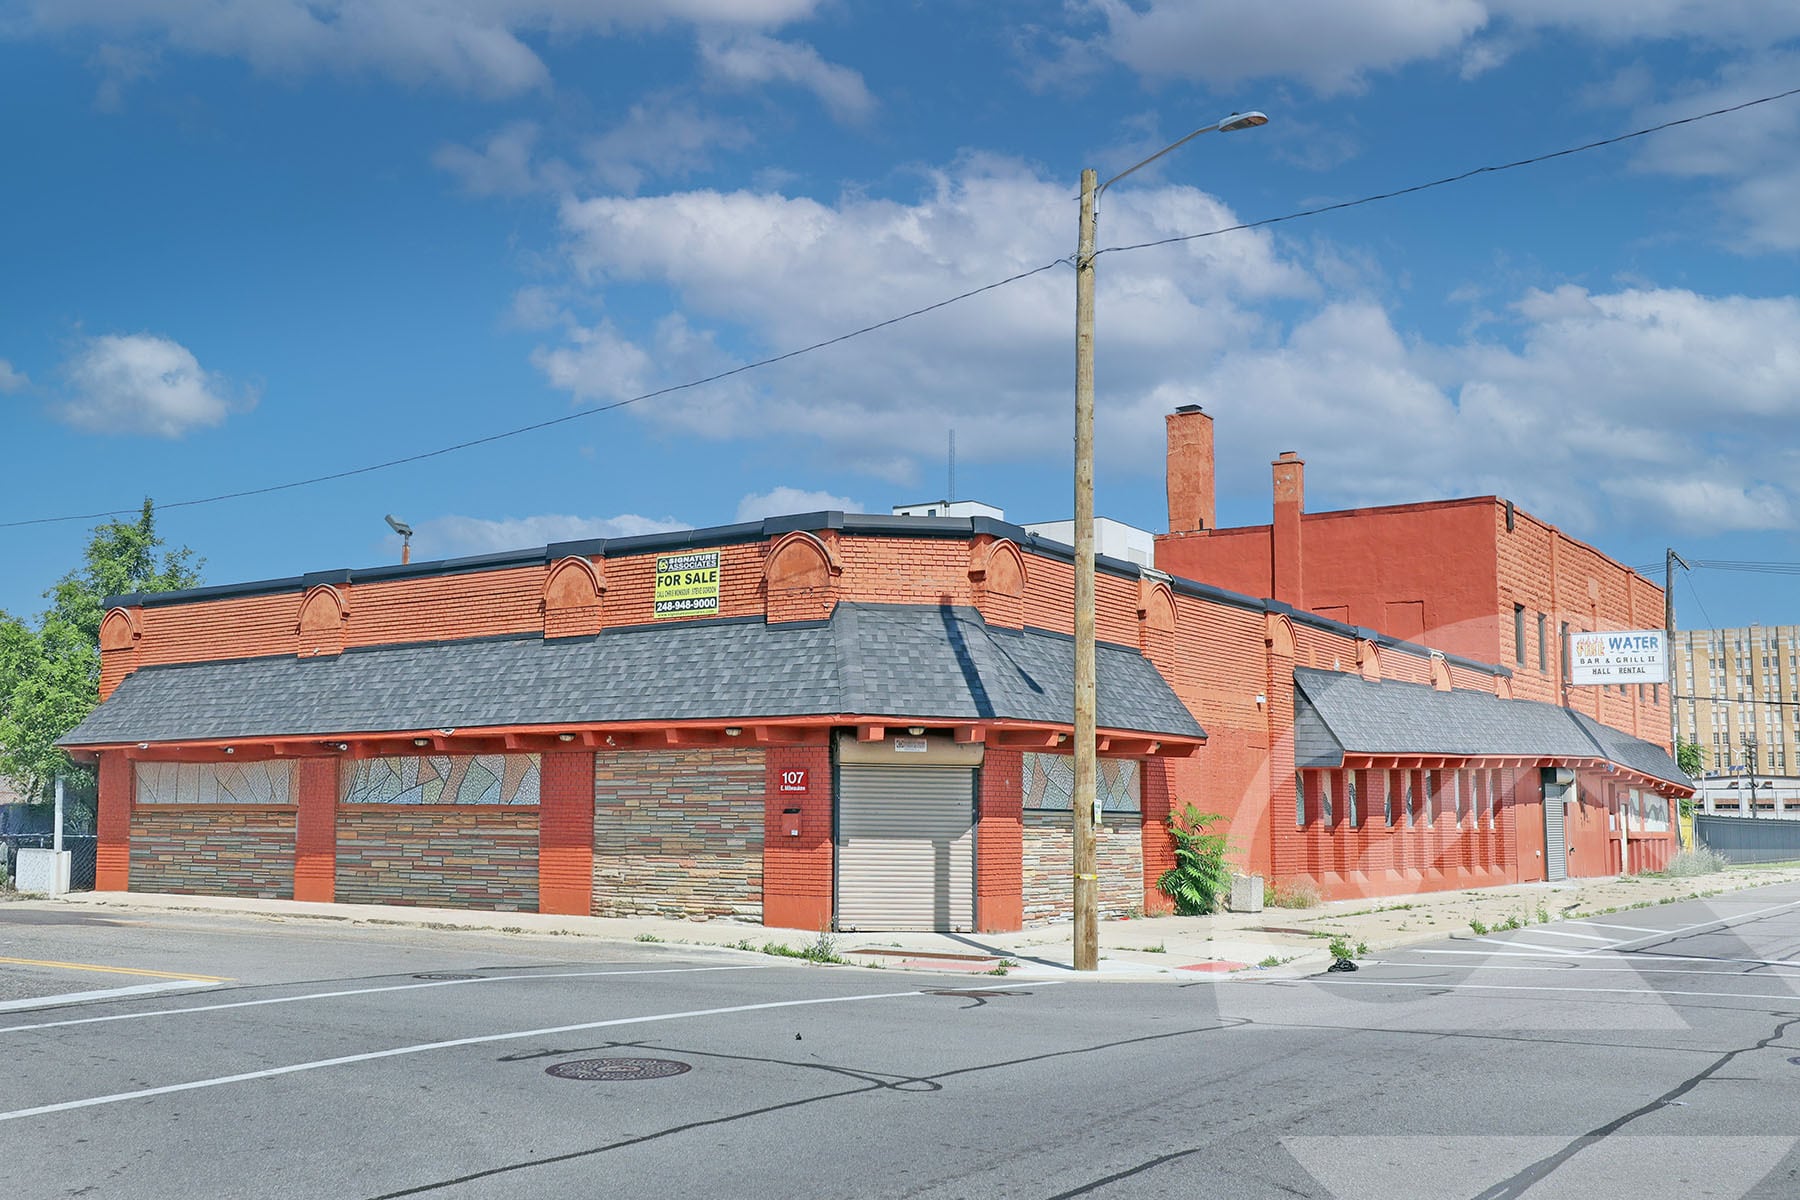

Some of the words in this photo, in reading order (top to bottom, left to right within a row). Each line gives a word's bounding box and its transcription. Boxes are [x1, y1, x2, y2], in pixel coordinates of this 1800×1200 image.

[668, 554, 716, 564] SIGNATURE
[668, 560, 716, 570] ASSOCIATES
[657, 574, 681, 588] FOR
[684, 571, 716, 584] SALE
[656, 598, 716, 612] 248-948-9000
[1576, 637, 1605, 657] FIRE
[1608, 636, 1659, 650] WATER
[782, 771, 805, 785] 107
